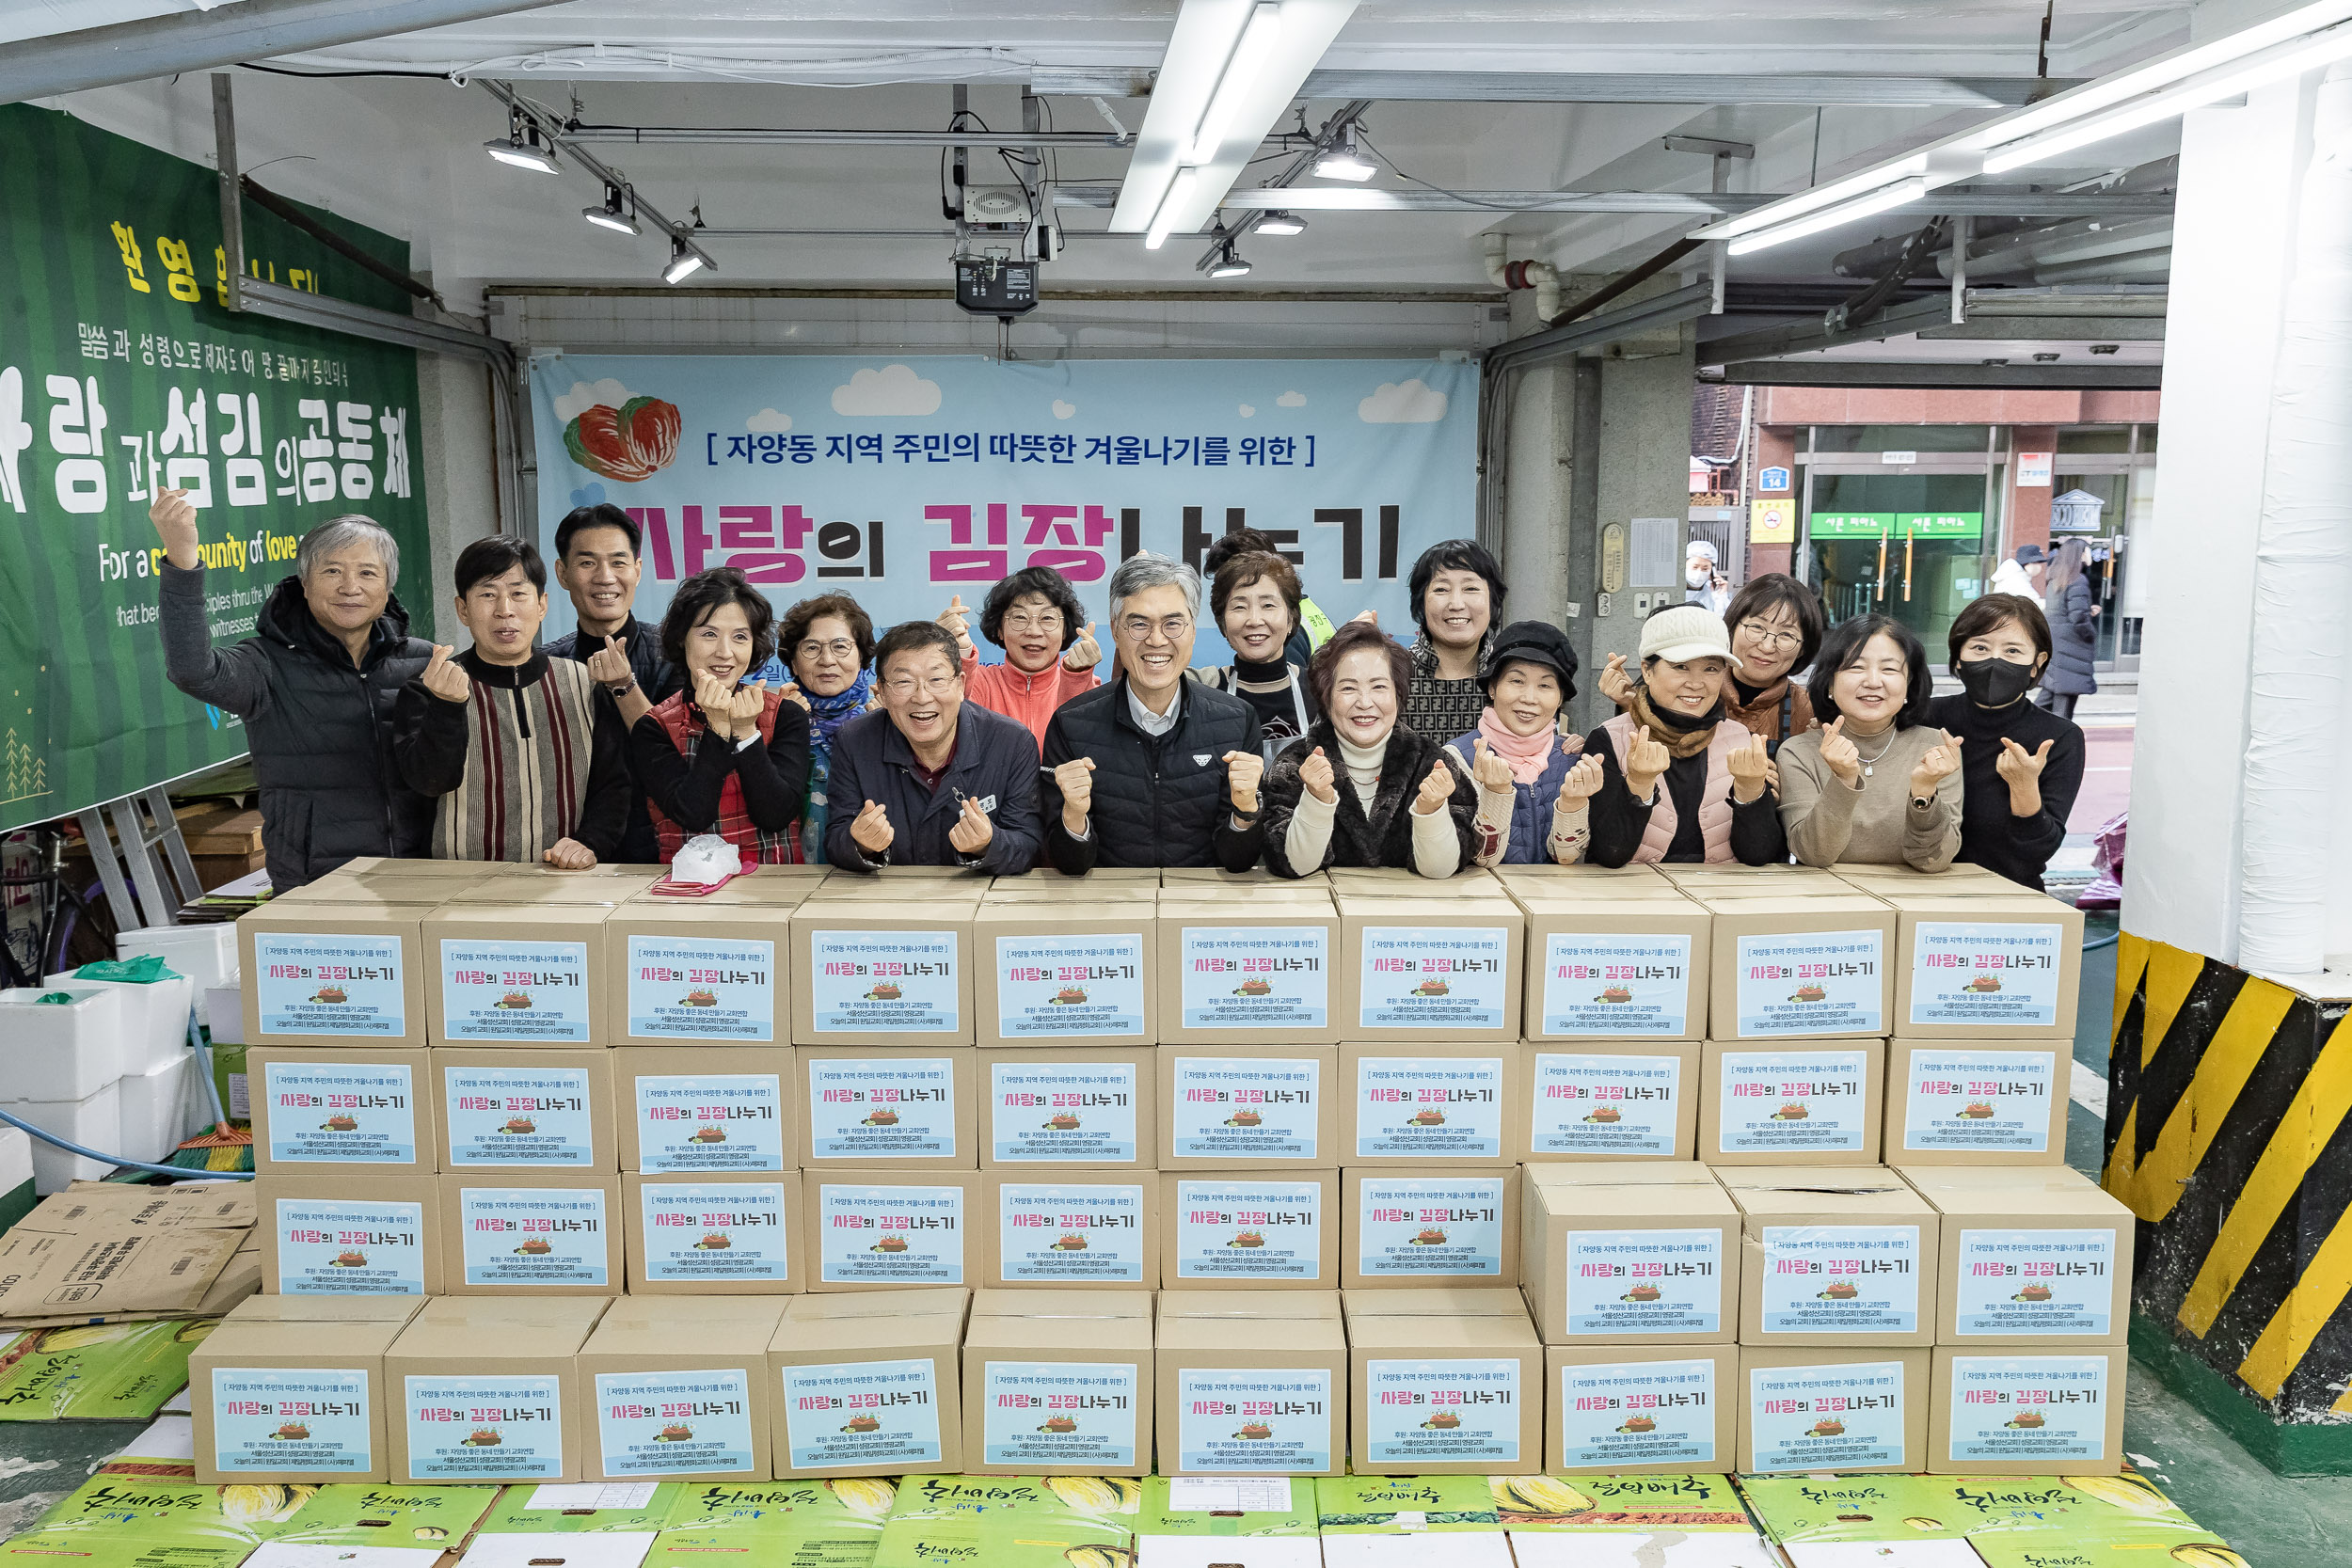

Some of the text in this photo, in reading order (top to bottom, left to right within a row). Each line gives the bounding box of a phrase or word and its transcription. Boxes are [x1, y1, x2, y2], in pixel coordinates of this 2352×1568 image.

[159, 387, 301, 508] 섬김의
[297, 398, 411, 502] 공동체
[726, 433, 815, 465] 자양동
[826, 433, 882, 464] 지역
[893, 433, 980, 464] 주민의
[989, 433, 1076, 465] 따뜻한
[1084, 434, 1231, 467] 겨울나기를
[1238, 436, 1296, 467] 위한
[1769, 478, 1781, 487] 14
[626, 505, 884, 583] 사랑의
[99, 543, 131, 582] For
[135, 552, 150, 578] a
[249, 534, 264, 563] of
[265, 530, 297, 561] love
[232, 589, 252, 609] thru
[825, 962, 949, 976] 사랑의 김장나누기
[1195, 958, 1319, 972] 사랑의 김장나누기
[1375, 958, 1498, 973] 사랑의 김장나누기
[1926, 954, 2051, 969] 사랑의 김장나누기
[269, 964, 394, 981] 사랑의 김장나누기
[641, 967, 765, 986] 사랑의 김장나누기
[1010, 966, 1135, 981] 사랑의 김장나누기
[1558, 965, 1680, 980] 사랑의 김장나누기
[1751, 962, 1873, 979] 사랑의 김장나누기
[455, 971, 579, 987] 사랑의 김장나누기
[823, 1089, 946, 1102] 사랑의 김장나누기
[1187, 1088, 1310, 1104] 사랑의 김장나누기
[1370, 1088, 1493, 1102] 사랑의 김장나누기
[1547, 1085, 1670, 1101] 사랑의 김장나누기
[1734, 1083, 1856, 1097] 사랑의 김장나누기
[1920, 1081, 2043, 1096] 사랑의 김장나누기
[280, 1093, 405, 1109] 사랑의 김장나누기
[459, 1097, 581, 1111] 사랑의 김장나누기
[1005, 1093, 1127, 1107] 사랑의 김장나누기
[650, 1106, 772, 1119] 사랑의 김장나누기
[656, 1213, 776, 1227] 사랑의 김장나누기
[834, 1215, 954, 1230] 사랑의 김장나누기
[1013, 1214, 1134, 1228] 사랑의 김장나누기
[1190, 1211, 1311, 1226] 사랑의 김장나누기
[1373, 1209, 1494, 1222] 사랑의 김장나누기
[475, 1218, 597, 1232] 사랑의 김장나누기
[291, 1229, 414, 1246] 사랑의 김장나누기
[1581, 1262, 1712, 1277] 사랑의 김장나누기
[1776, 1259, 1910, 1274] 사랑의 김장나누기
[1972, 1262, 2105, 1276] 사랑의 김장나누기
[799, 1391, 928, 1411] 사랑의 김장나누기
[998, 1394, 1127, 1410] 사랑의 김장나누기
[1381, 1391, 1510, 1404] 사랑의 김장나누기
[1576, 1392, 1706, 1411] 사랑의 김장나누기
[1965, 1389, 2097, 1403] 사랑의 김장나누기
[228, 1402, 359, 1417] 사랑의 김장나누기
[612, 1402, 740, 1418] 사랑의 김장나누기
[1193, 1402, 1322, 1416] 사랑의 김장나누기
[1765, 1395, 1895, 1414] 사랑의 김장나누기
[420, 1408, 551, 1421] 사랑의 김장나누기
[920, 1479, 1039, 1503] 절임배추
[1589, 1474, 1712, 1500] 절임배추
[700, 1486, 818, 1512] 절임배추
[1356, 1486, 1443, 1504] 절임배추
[1956, 1487, 2083, 1513] 절임배추
